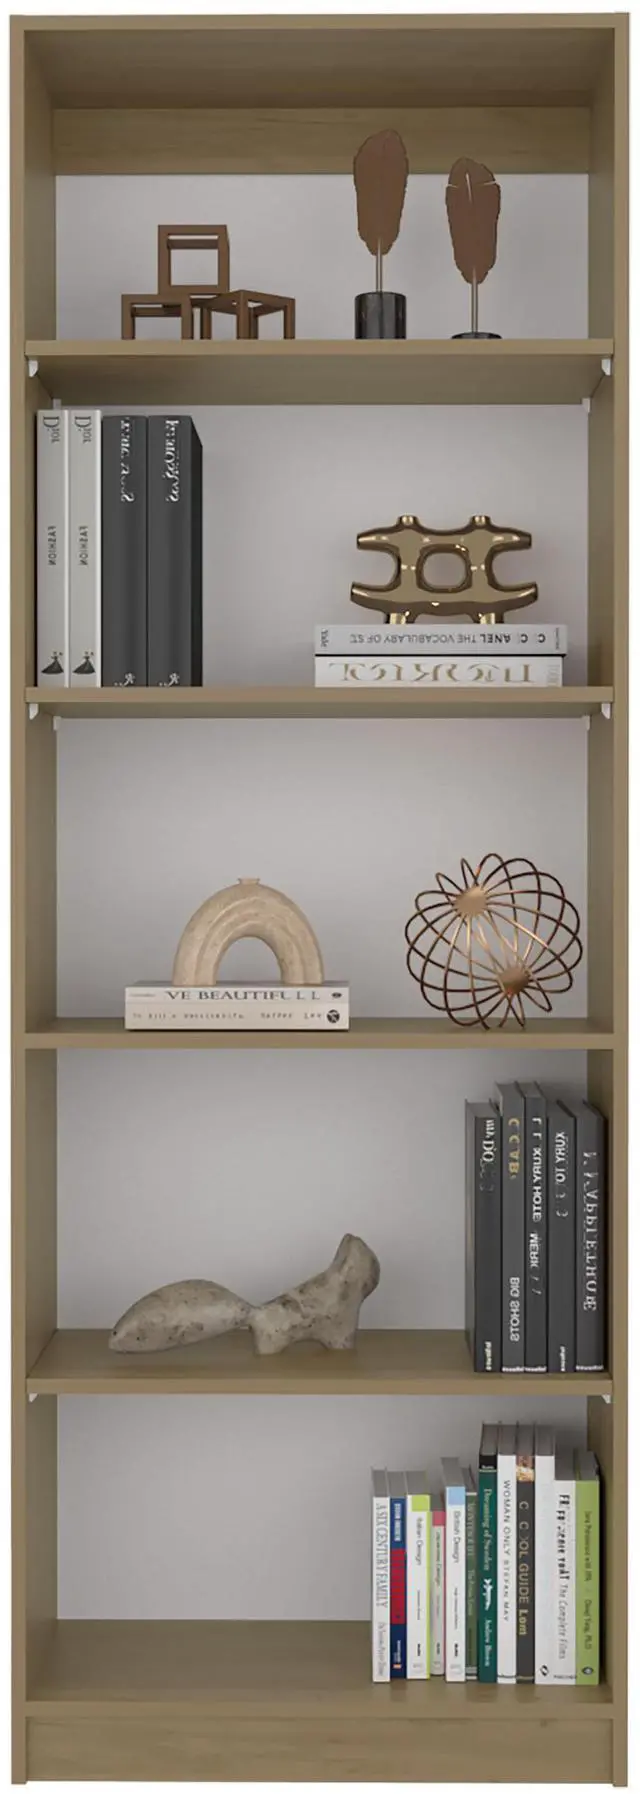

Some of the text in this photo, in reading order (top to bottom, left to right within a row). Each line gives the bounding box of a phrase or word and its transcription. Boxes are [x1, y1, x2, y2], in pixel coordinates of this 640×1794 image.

[457, 633, 476, 643] THE
[502, 1480, 511, 1523] WOMAN
[376, 1527, 389, 1571] CENTURY
[502, 1527, 511, 1556] ONLY
[376, 1573, 389, 1608] FAMILY
[518, 1564, 529, 1604] GUIDE
